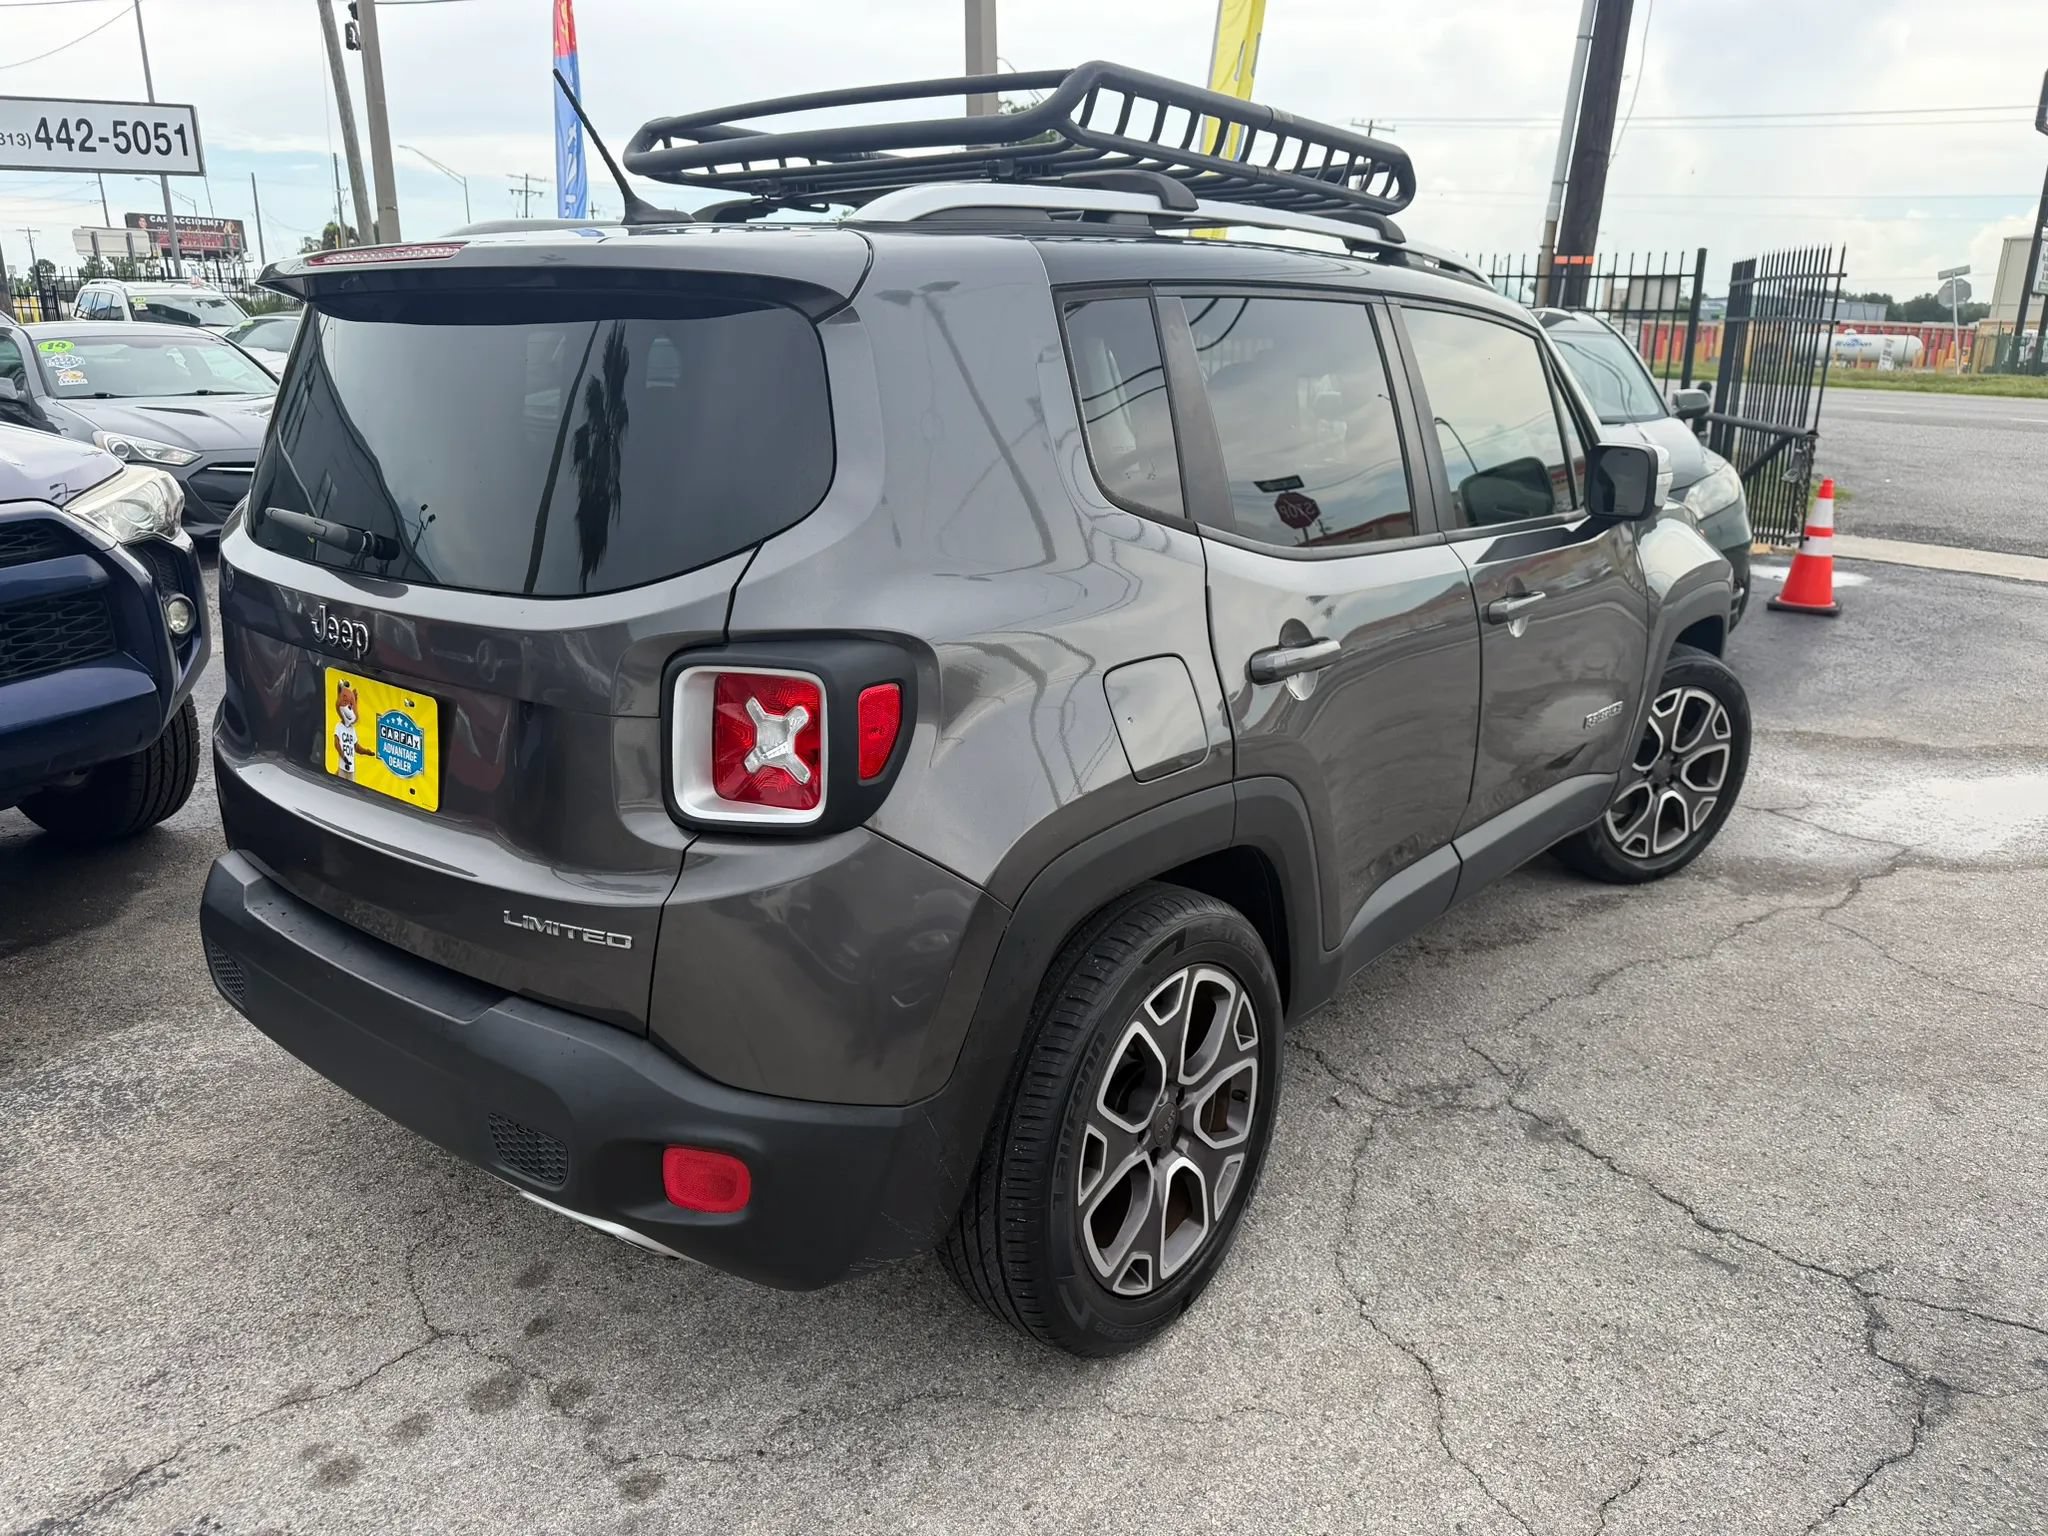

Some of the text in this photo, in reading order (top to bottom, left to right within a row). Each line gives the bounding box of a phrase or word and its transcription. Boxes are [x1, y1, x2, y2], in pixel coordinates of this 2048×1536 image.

[34, 116, 189, 157] 442-5051
[311, 602, 369, 660] Jeep
[341, 732, 354, 745] CAR
[381, 726, 420, 750] CARFAX
[342, 744, 354, 757] FOX
[383, 742, 418, 763] ADVANTAGE
[388, 755, 412, 773] DEALER
[503, 910, 632, 949] LIMITED
